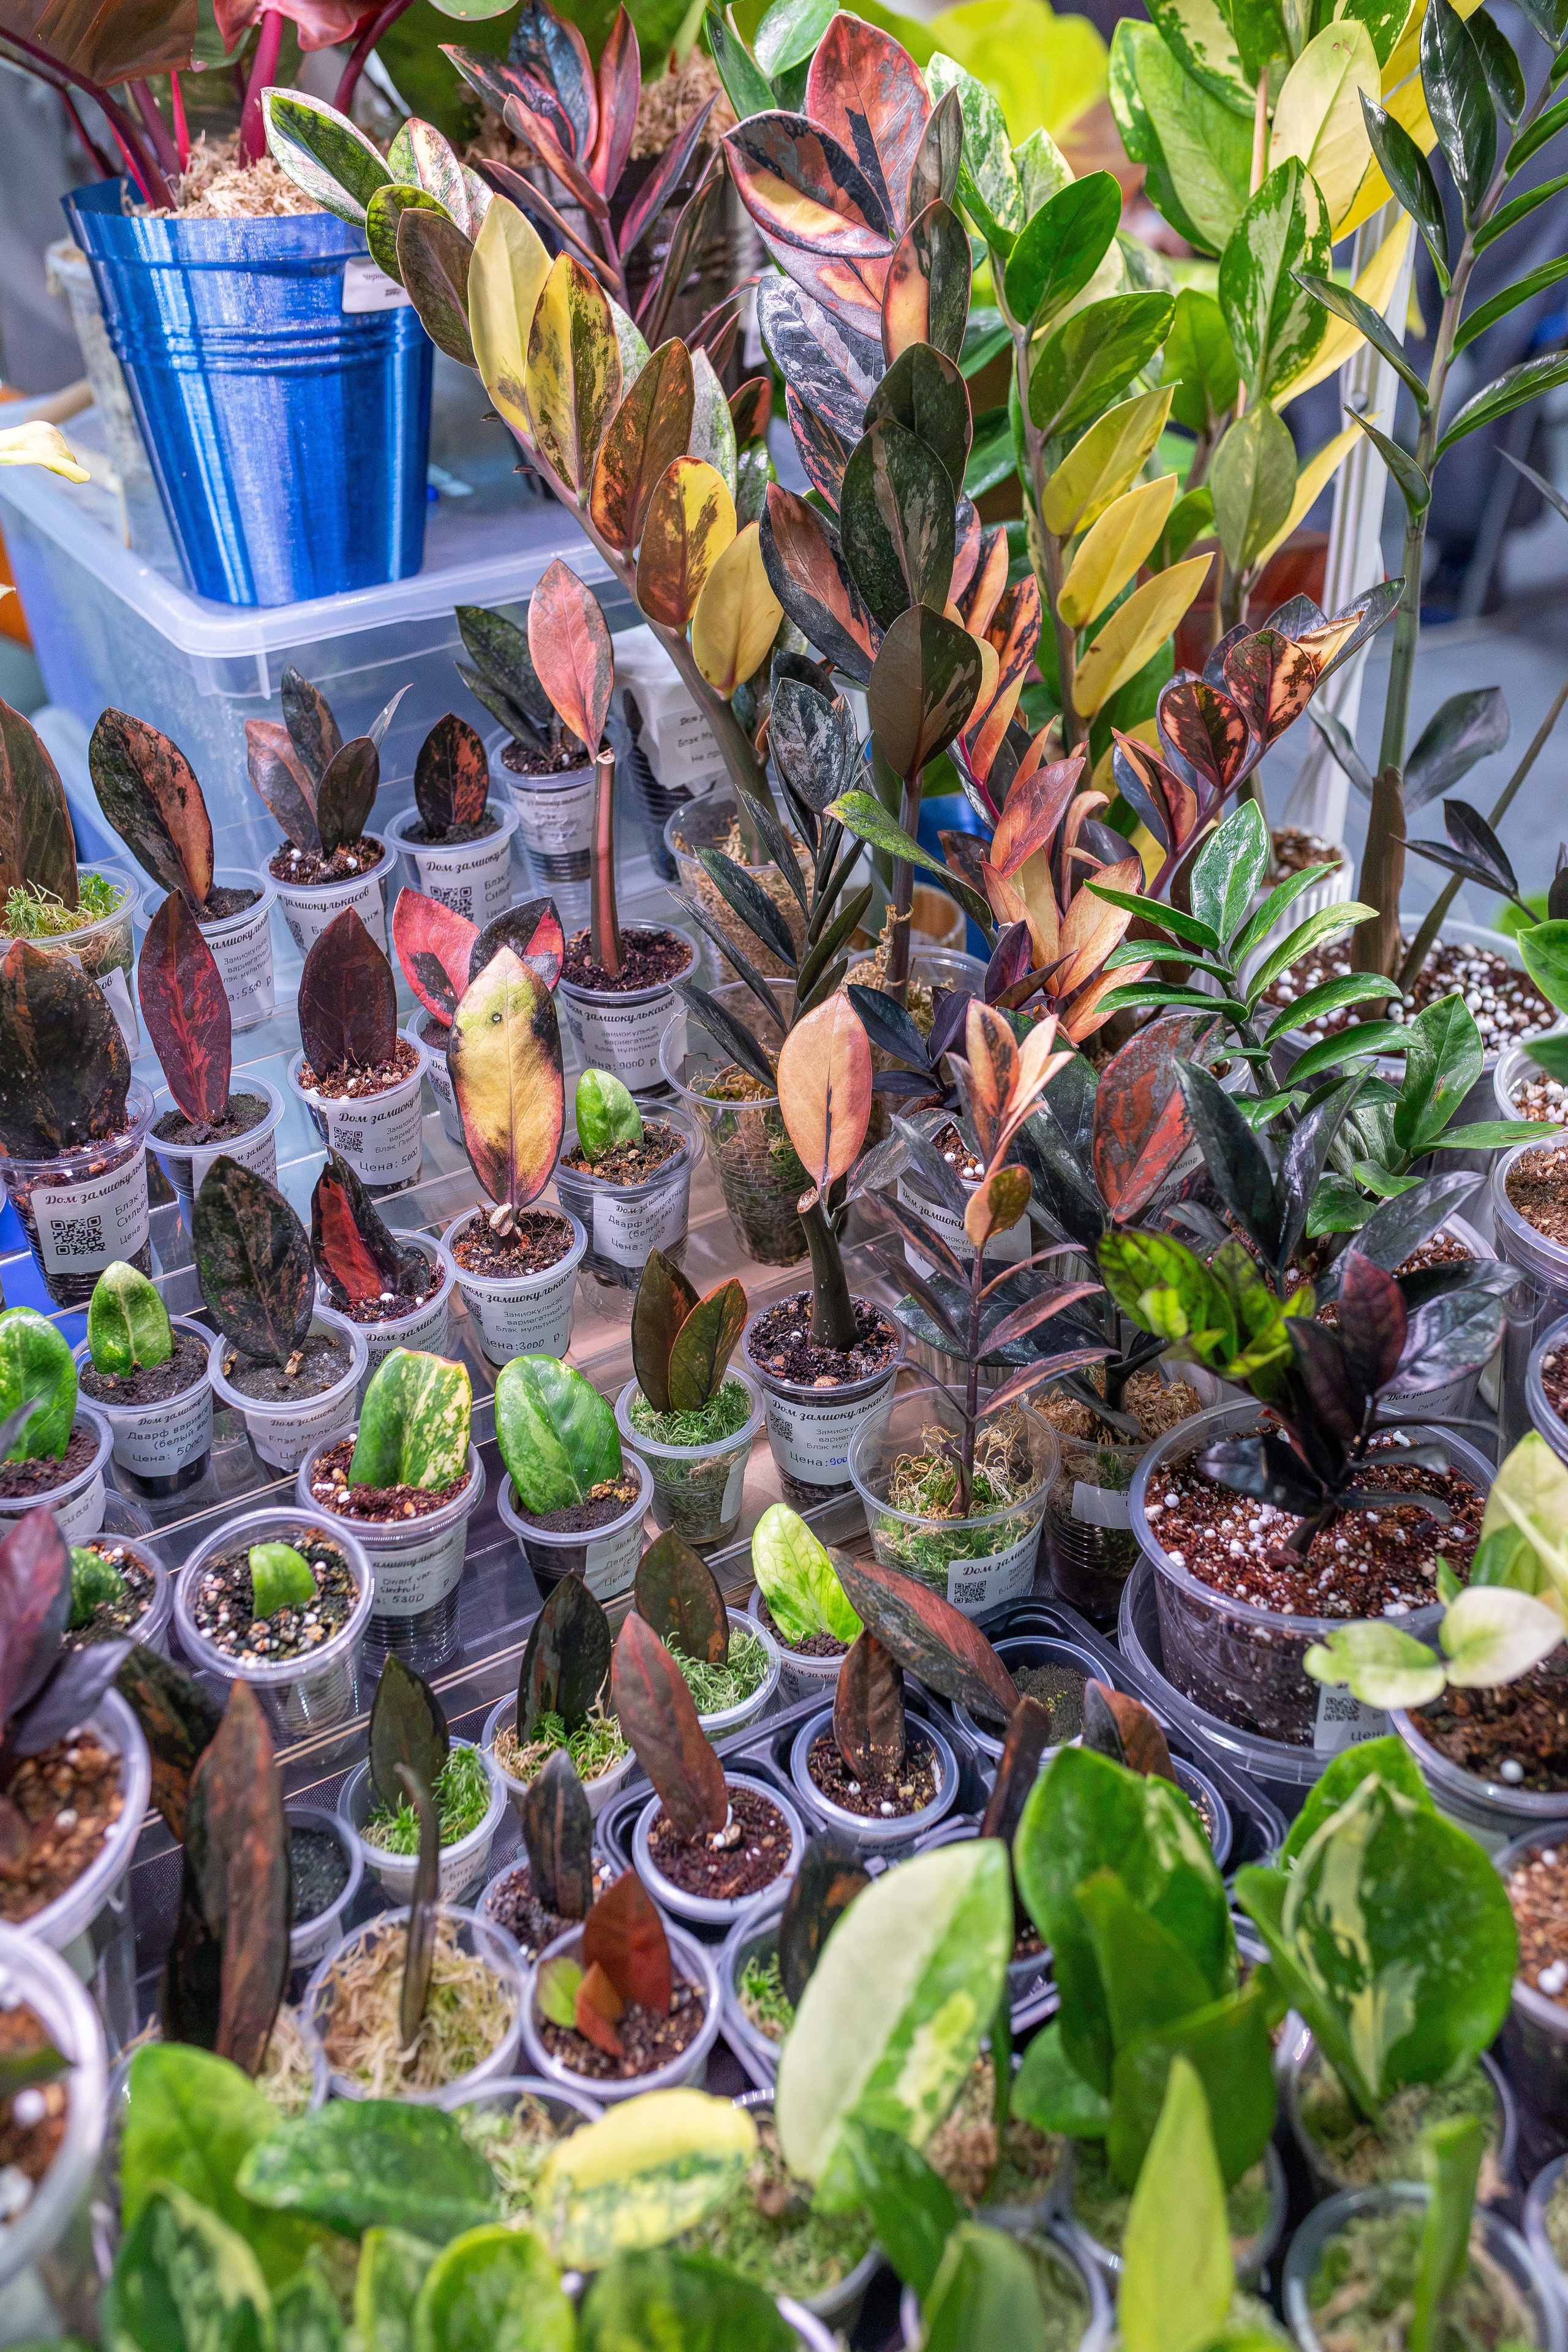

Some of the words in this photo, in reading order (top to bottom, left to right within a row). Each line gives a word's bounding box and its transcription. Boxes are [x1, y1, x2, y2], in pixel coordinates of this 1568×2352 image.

[426, 861, 453, 872] Дом
[284, 886, 369, 913] замиокулькасов
[585, 996, 675, 1024] замиокулькасов
[339, 1112, 368, 1123] Дом
[375, 1145, 396, 1153] Блэк
[360, 1161, 398, 1172] Цена:
[45, 1195, 77, 1205] Дом
[115, 1194, 139, 1216] Блэк
[903, 1187, 918, 1209] Дом
[609, 1215, 643, 1230] Дварф
[611, 1237, 643, 1251] Цена:
[503, 1296, 564, 1317] Замиокулькас
[507, 1305, 563, 1325] вариегатный
[521, 1305, 571, 1333] мультиколор
[366, 1333, 397, 1341] Дом
[773, 1400, 797, 1417] Дом
[799, 1384, 890, 1421] замиокулькасов
[138, 1417, 162, 1426] Дом
[127, 1430, 169, 1441] Дварф
[154, 1428, 194, 1450] (белый
[133, 1454, 170, 1463] Цена:
[790, 1451, 828, 1467] Цена:
[962, 1565, 992, 1575] Дом
[785, 1662, 805, 1675] Дом
